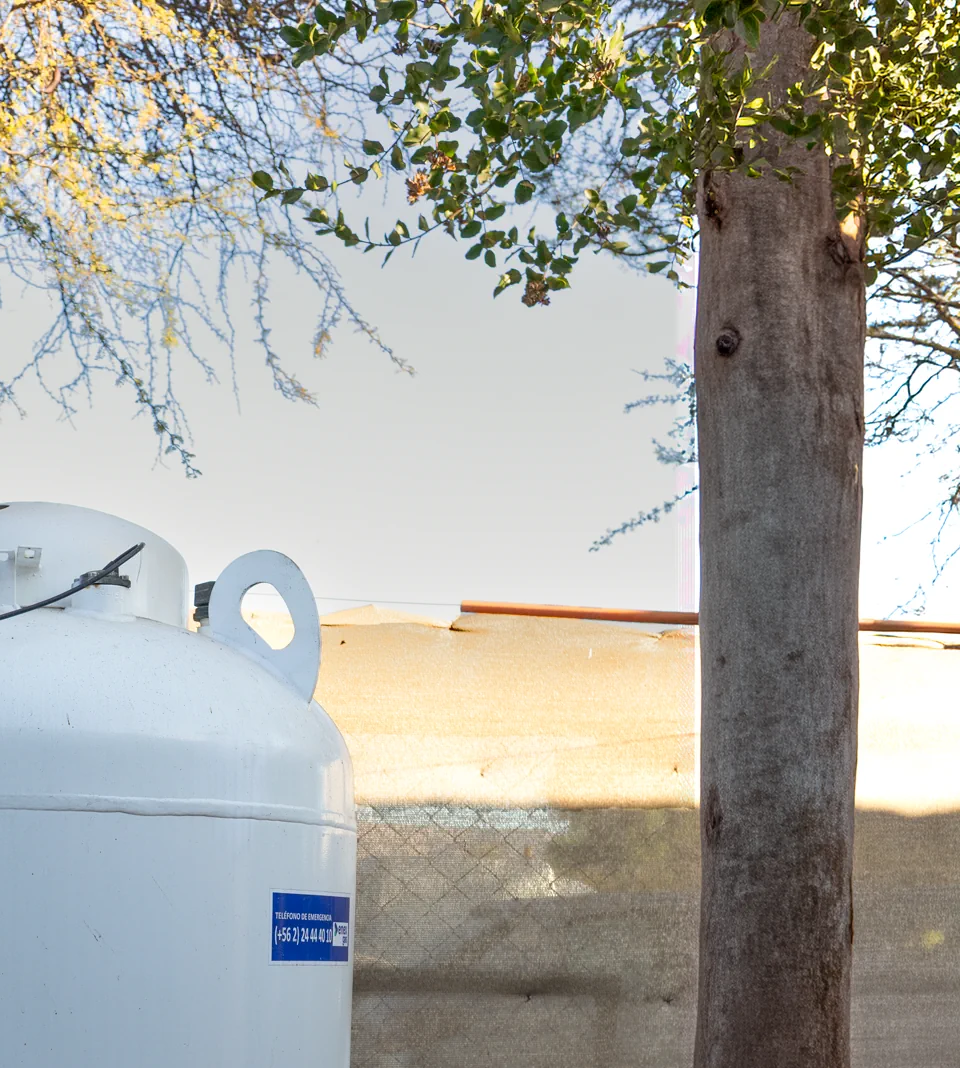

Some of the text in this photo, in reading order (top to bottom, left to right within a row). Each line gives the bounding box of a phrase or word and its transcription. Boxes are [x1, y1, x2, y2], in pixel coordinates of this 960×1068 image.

[275, 911, 300, 920] TELÉFONO
[275, 926, 291, 945] (+56
[292, 926, 299, 945] 2)
[301, 928, 309, 942] 24
[310, 928, 317, 942] 44
[319, 928, 325, 943] 40
[326, 929, 332, 943] 10
